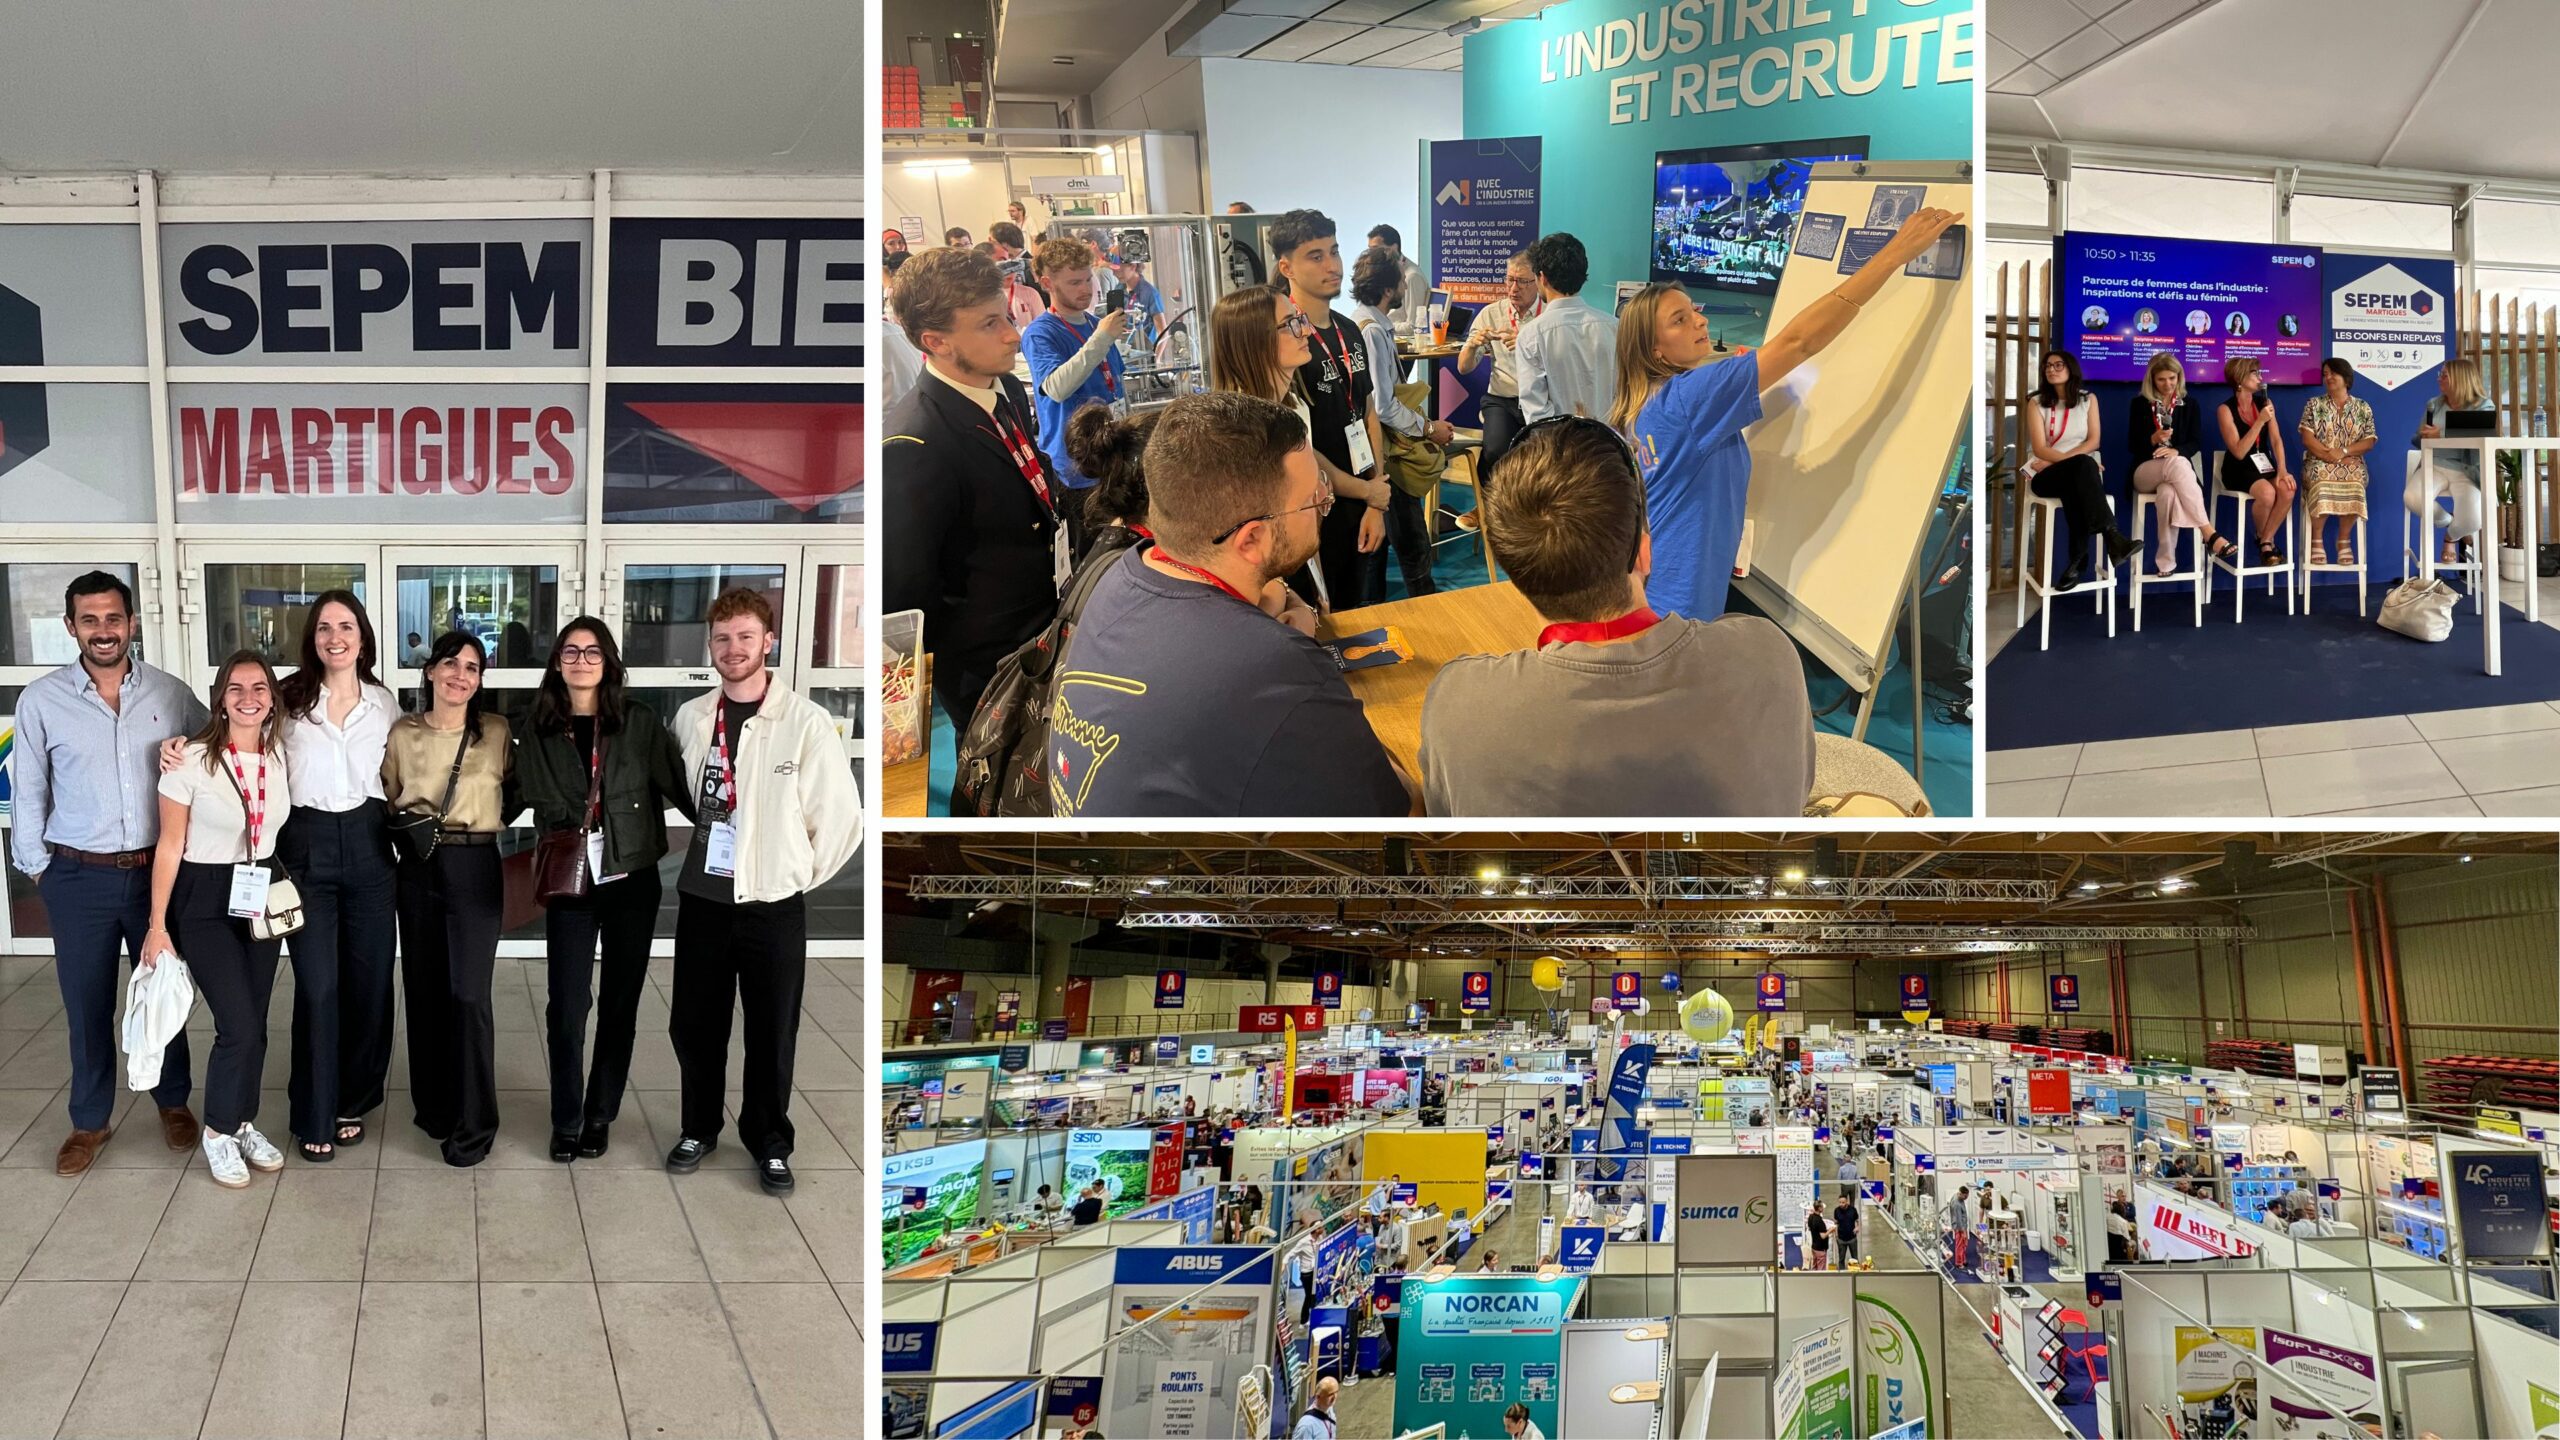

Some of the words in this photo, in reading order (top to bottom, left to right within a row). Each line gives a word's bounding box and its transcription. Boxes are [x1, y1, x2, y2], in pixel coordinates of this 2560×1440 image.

[1609, 73, 1659, 125] ET
[1670, 10, 1973, 117] RECRUTE
[1476, 178, 1501, 189] AVEC
[1476, 189, 1534, 200] L'INDUSTRIE
[1441, 220, 1457, 228] Que
[1497, 219, 1525, 227] sentiez
[1441, 229, 1461, 237] l'âme
[1462, 229, 1479, 237] d'un
[1480, 229, 1512, 237] créateur
[1441, 238, 1457, 246] prêt
[1458, 238, 1463, 246] à
[1464, 238, 1482, 246] bâtir
[1483, 238, 1490, 246] le
[1492, 238, 1518, 246] monde
[1682, 235, 1702, 247] VERS
[1704, 238, 1744, 257] L'INFINI
[1747, 245, 1762, 262] ET
[1452, 248, 1481, 256] demain,
[2084, 248, 2117, 261] 10:50
[2129, 249, 2156, 262] 11:35
[2271, 255, 2303, 265] SEPEM
[1458, 257, 1492, 266] ingénieur
[1455, 265, 1493, 273] l'économie
[1441, 275, 1481, 284] ressources,
[2082, 276, 2129, 288] Parcours
[2131, 278, 2145, 287] de
[2147, 278, 2188, 290] femmes
[2189, 281, 2214, 291] dans
[2215, 283, 2264, 293] l'industrie
[657, 238, 864, 348] BIE
[1471, 283, 1494, 291] métier
[179, 242, 581, 356] SEPEM
[1460, 292, 1478, 300] dans
[2082, 287, 2144, 300] Inspirations
[2145, 290, 2156, 300] et
[2158, 289, 2184, 300] défis
[2186, 292, 2199, 301] au
[2200, 291, 2238, 303] féminin
[2344, 293, 2407, 309] SEPEM
[2335, 331, 2352, 340] LES
[2353, 332, 2388, 341] CONFS
[2390, 333, 2401, 341] EN
[2402, 334, 2442, 343] REPLAYS
[180, 406, 576, 496] MARTIGUES
[1165, 974, 1176, 990] A
[1323, 974, 1332, 991] B
[1473, 976, 1482, 991] C
[1622, 977, 1631, 991] D
[1767, 978, 1775, 992] E
[1910, 978, 1918, 993] F
[2060, 979, 2069, 993] G
[1258, 1012, 1278, 1026] RS
[1304, 1012, 1317, 1025] RS
[1312, 1066, 1326, 1075] RS
[2031, 1072, 2055, 1081] META
[1073, 1132, 1102, 1143] SISTO
[904, 1156, 935, 1170] KSB
[1680, 1205, 1740, 1220] sumca
[2189, 1219, 2228, 1249] HIFI
[1165, 1255, 1224, 1270] ABUS
[1445, 1296, 1539, 1313] NORCAN
[2198, 1351, 2228, 1360] MACHINES
[1170, 1371, 1197, 1381] PONTS
[2296, 1361, 2336, 1380] INDUSTRIE
[1161, 1382, 1204, 1392] ROULANTS
[1078, 1408, 1090, 1421] D5
